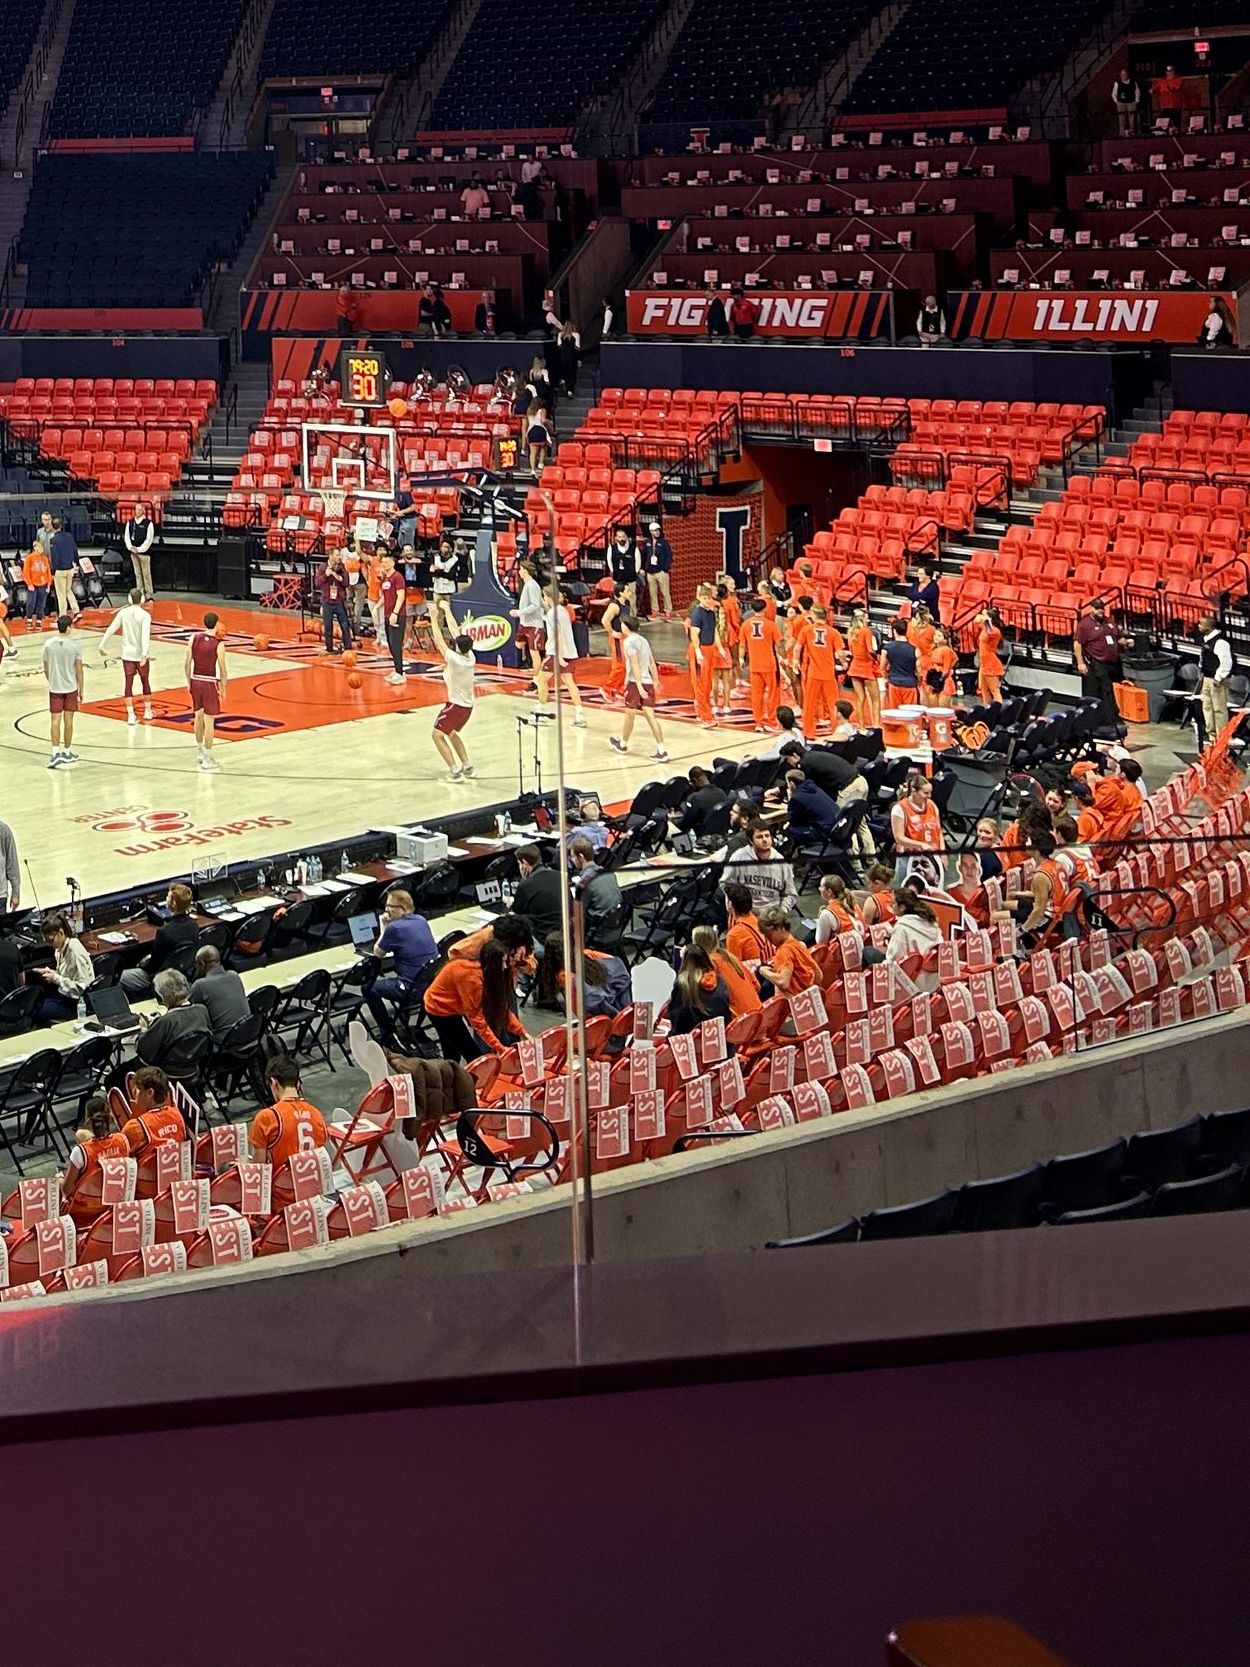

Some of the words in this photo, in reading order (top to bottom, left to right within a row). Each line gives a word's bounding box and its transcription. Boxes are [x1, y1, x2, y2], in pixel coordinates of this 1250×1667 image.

[641, 297, 829, 328] FIGING
[1033, 298, 1160, 332] ILLINI
[349, 358, 378, 374] 79:20
[352, 374, 377, 401] 30
[501, 452, 515, 468] 30
[1090, 914, 1104, 927] 11
[157, 1123, 178, 1138] RICO
[296, 1122, 315, 1152] 6
[463, 1140, 478, 1157] 12
